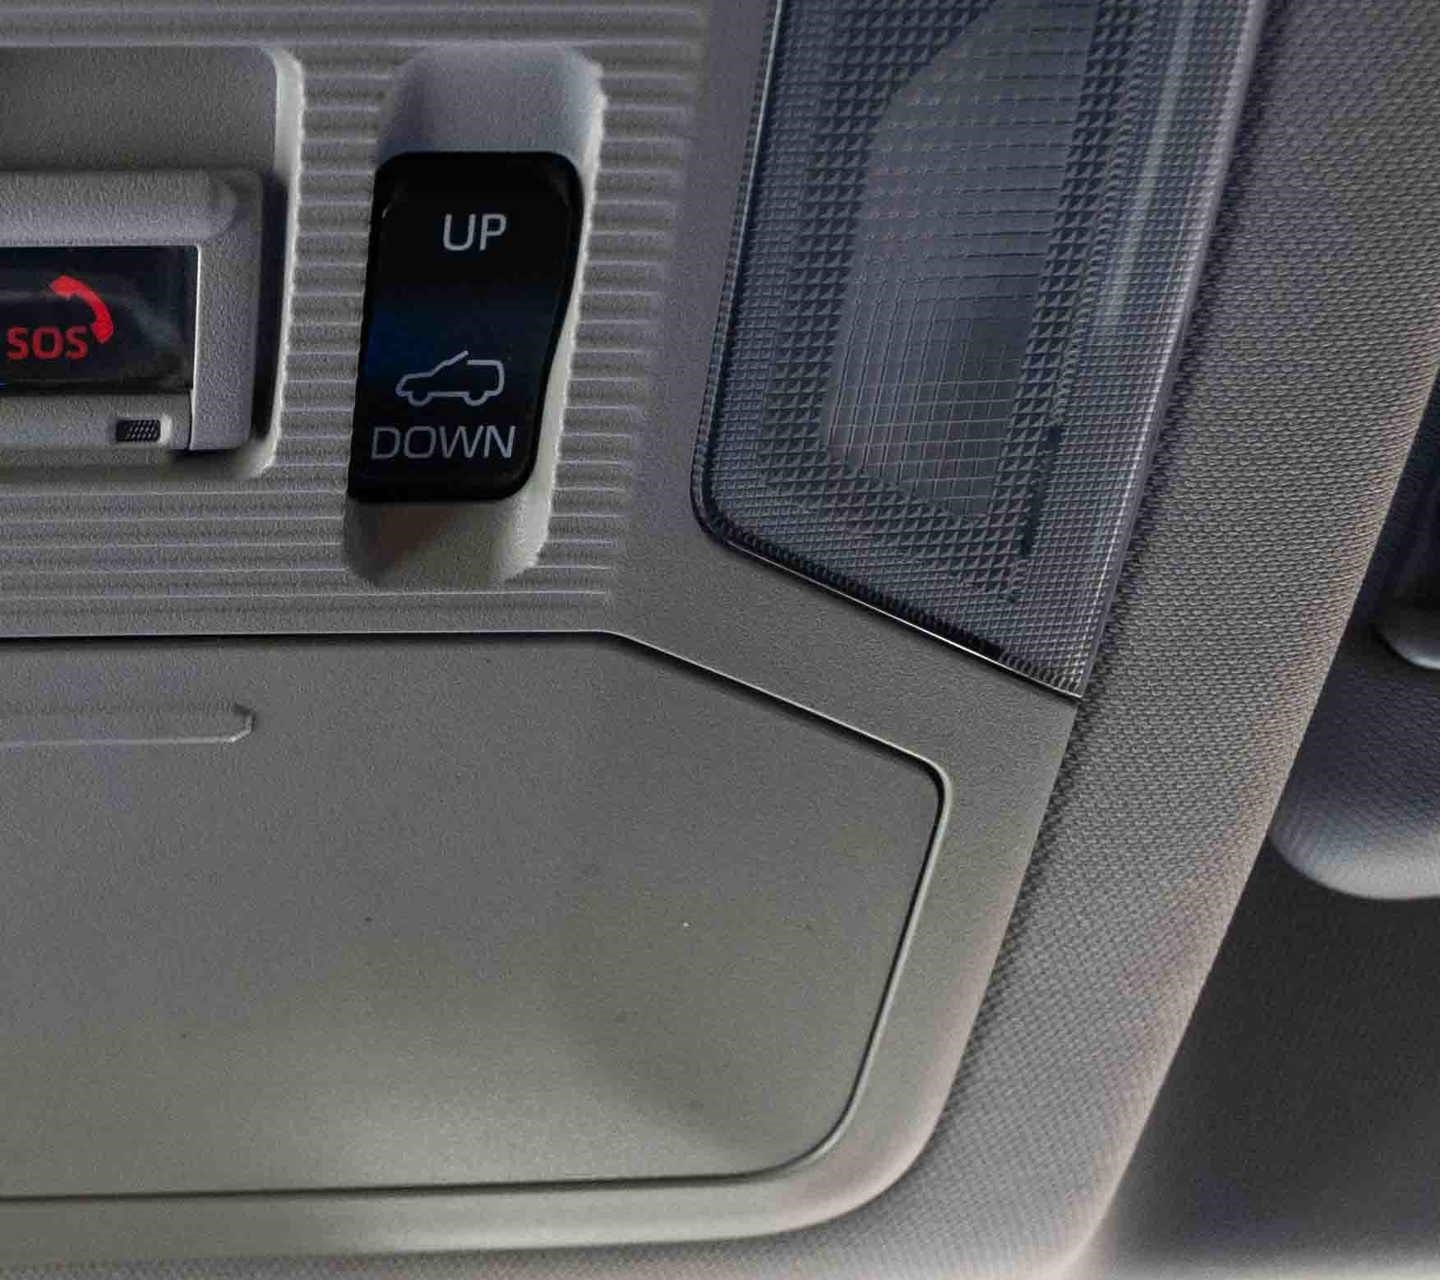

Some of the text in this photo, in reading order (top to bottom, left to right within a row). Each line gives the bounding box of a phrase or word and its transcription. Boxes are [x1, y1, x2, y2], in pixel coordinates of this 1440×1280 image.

[441, 212, 508, 252] UP
[6, 324, 89, 361] SOS
[370, 425, 516, 460] DOWN
